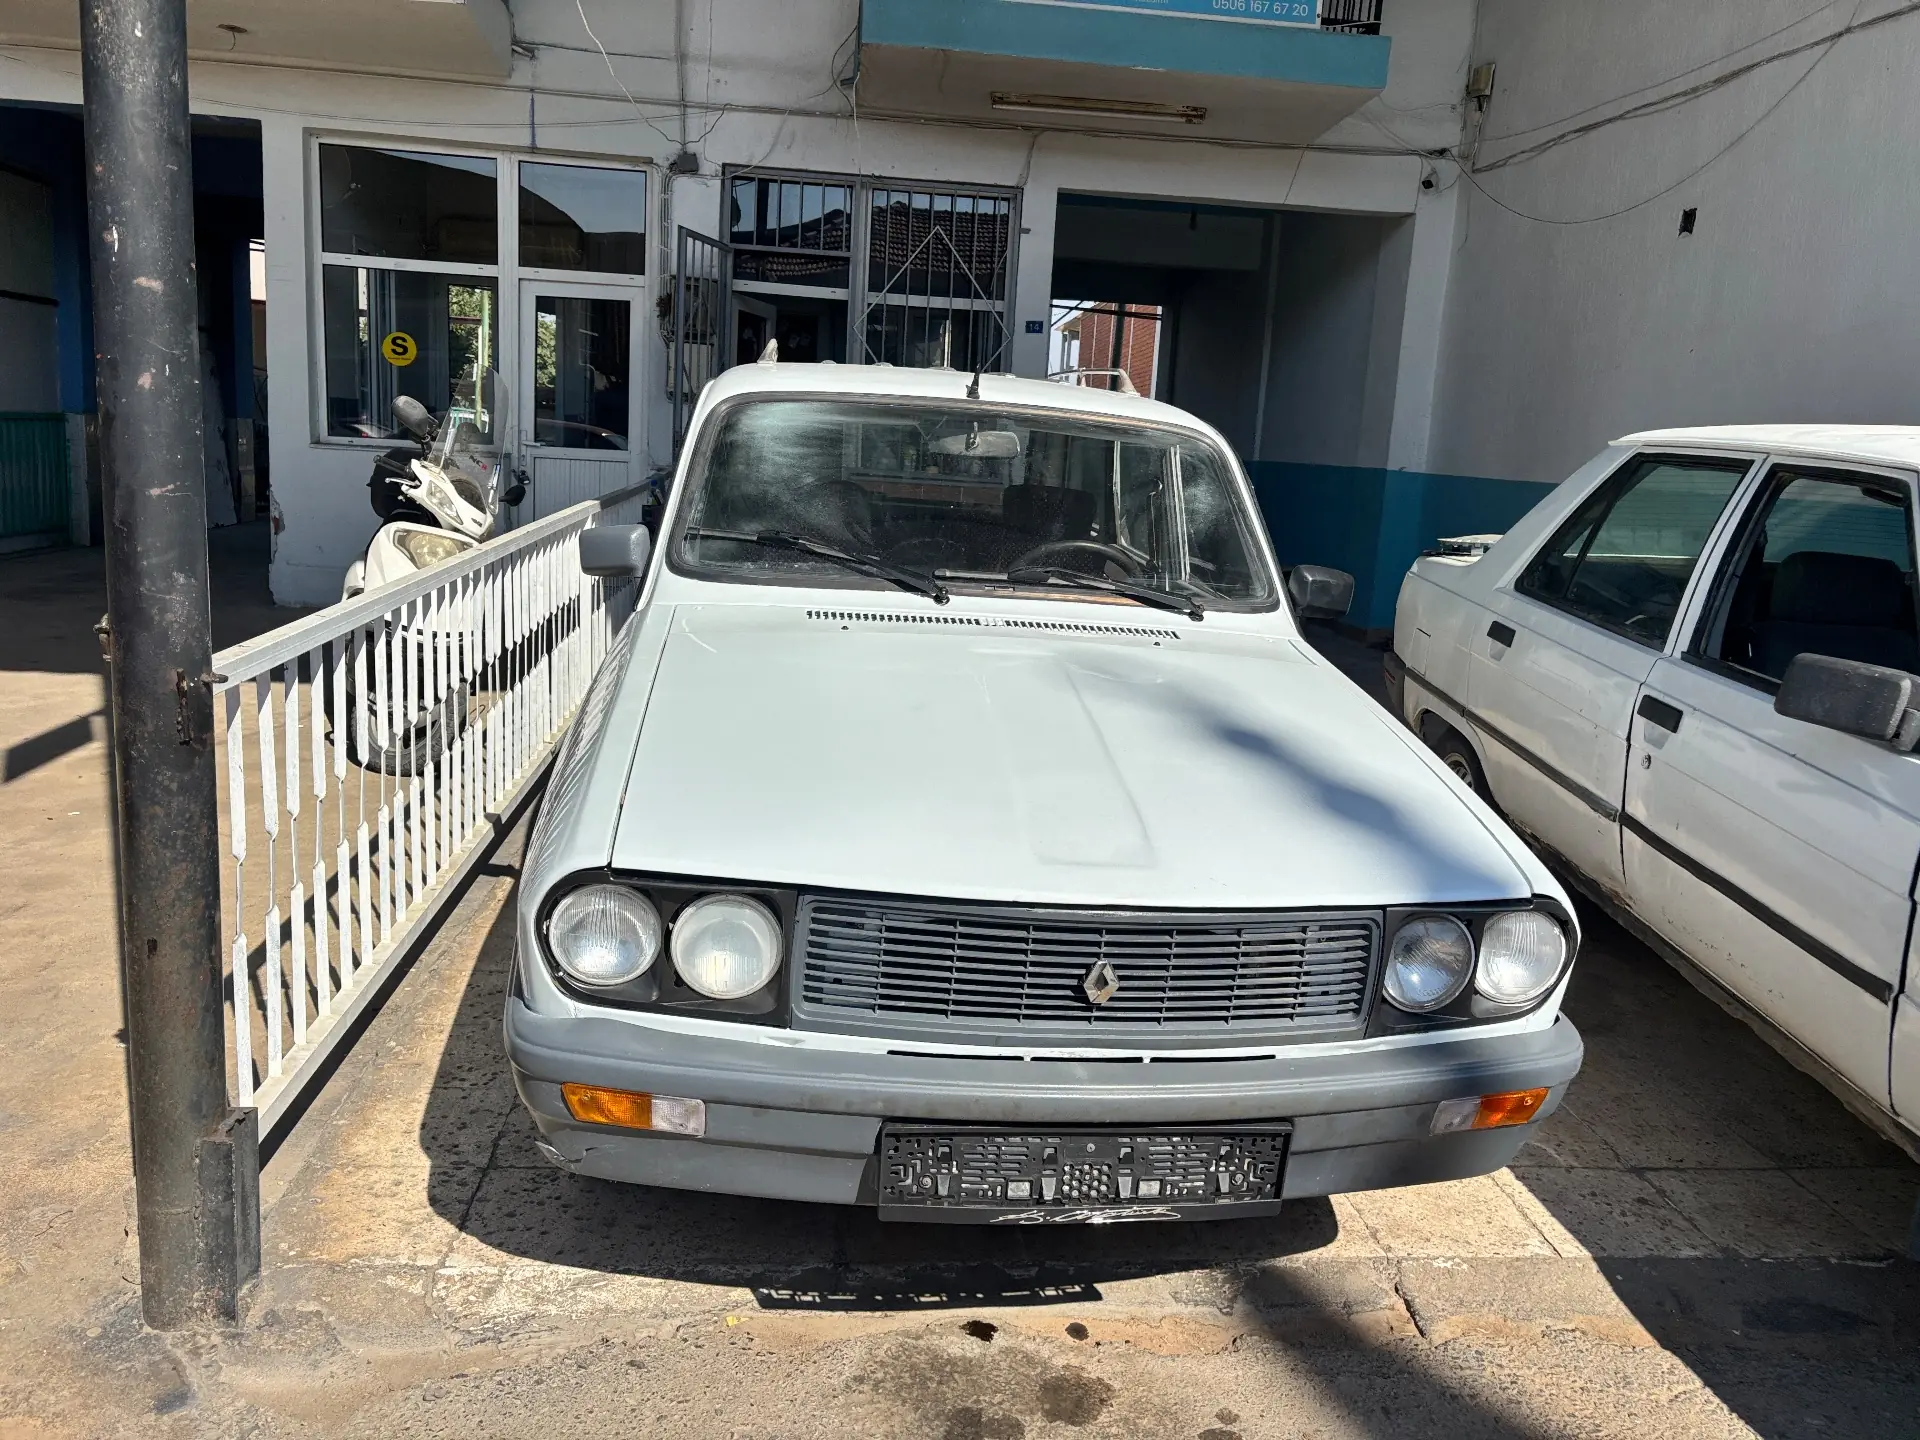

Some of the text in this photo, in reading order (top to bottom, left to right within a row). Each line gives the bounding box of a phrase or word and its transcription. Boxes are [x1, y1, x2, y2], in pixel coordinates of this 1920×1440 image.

[1212, 0, 1309, 17] 0506 167 67 20
[391, 335, 409, 356] S
